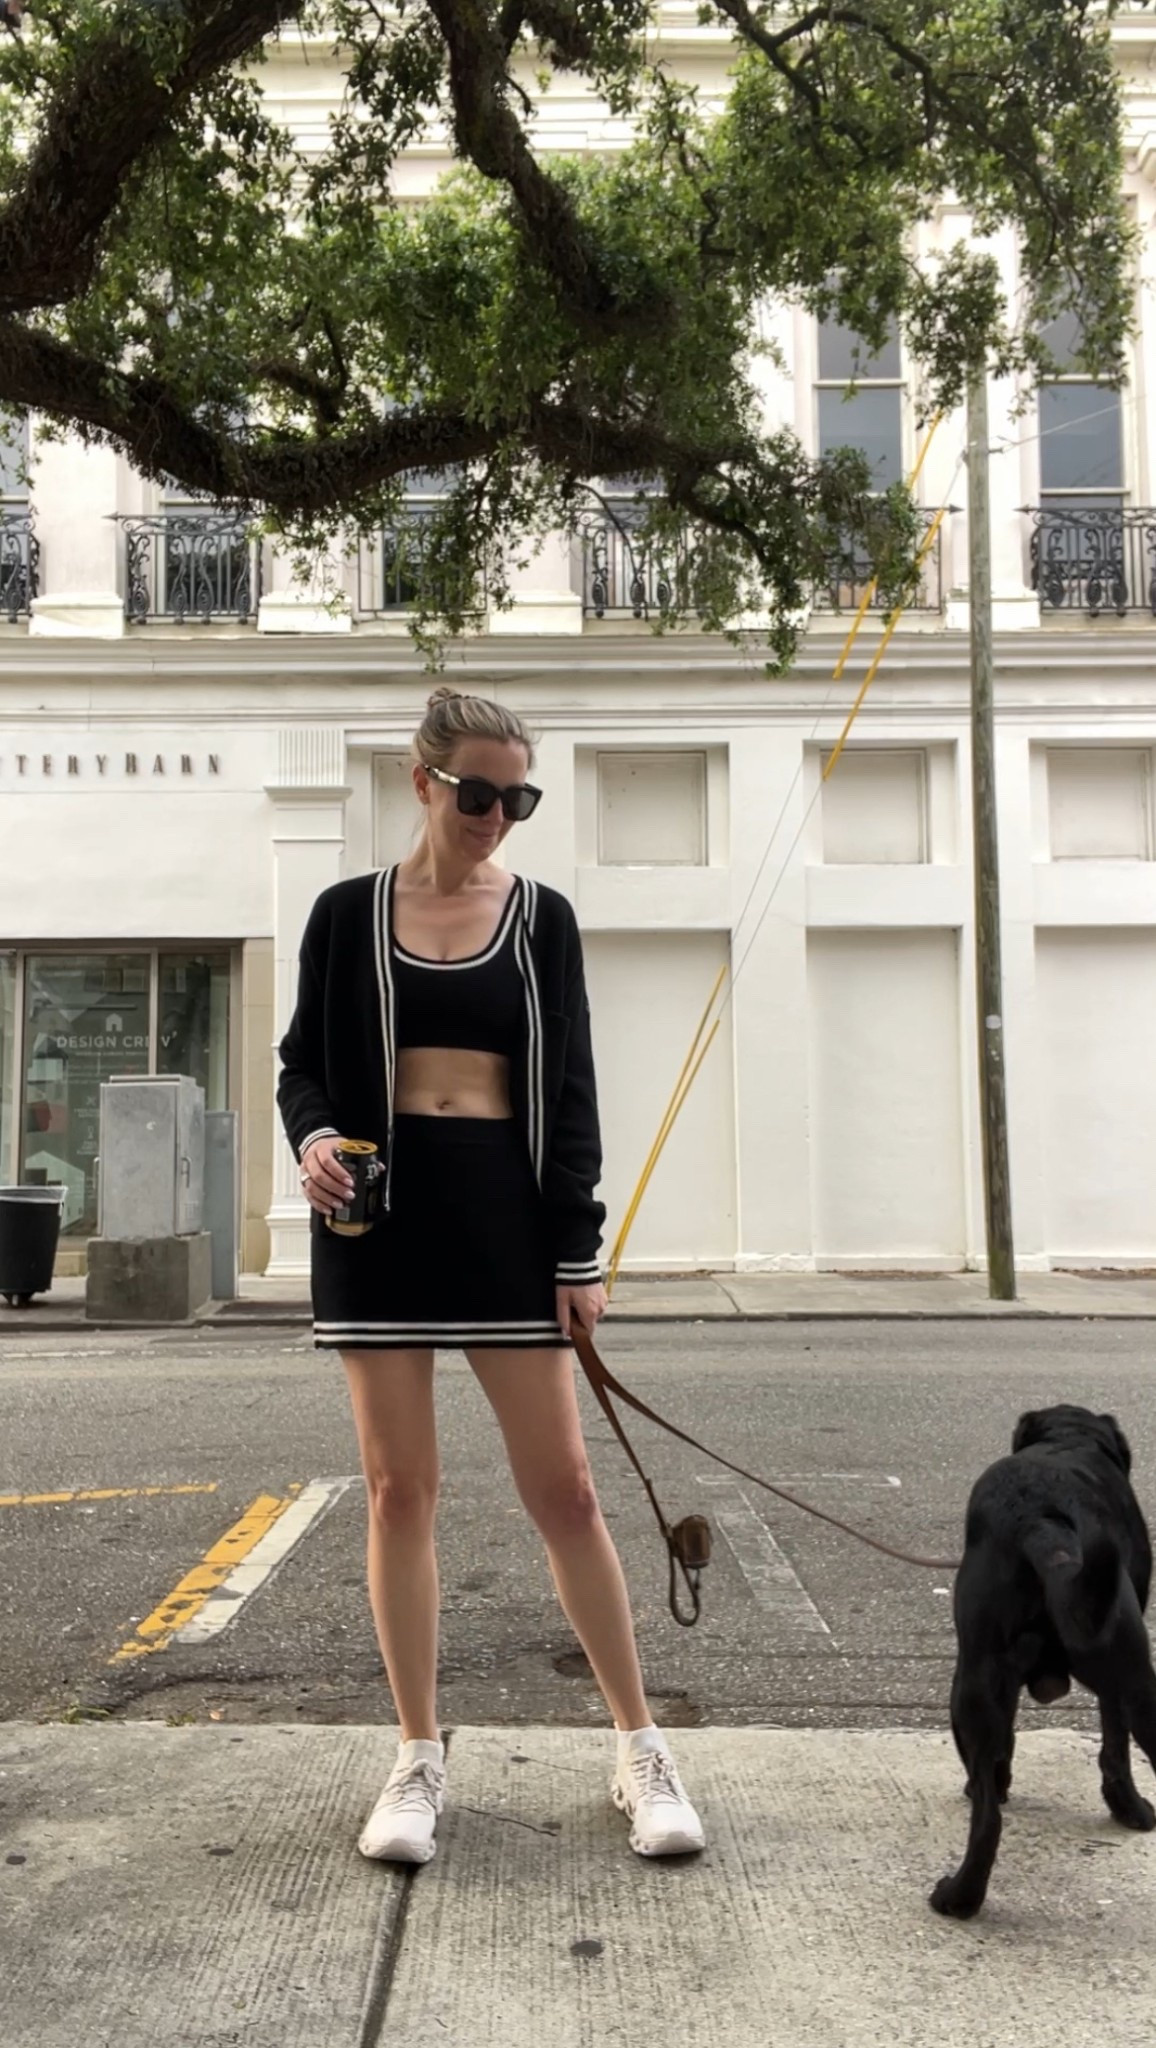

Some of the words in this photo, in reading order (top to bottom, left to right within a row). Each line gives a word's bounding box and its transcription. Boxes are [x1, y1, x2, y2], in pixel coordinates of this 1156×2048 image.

[0, 754, 107, 774] TERY
[125, 753, 218, 774] BARN
[56, 1035, 117, 1048] DESIGN
